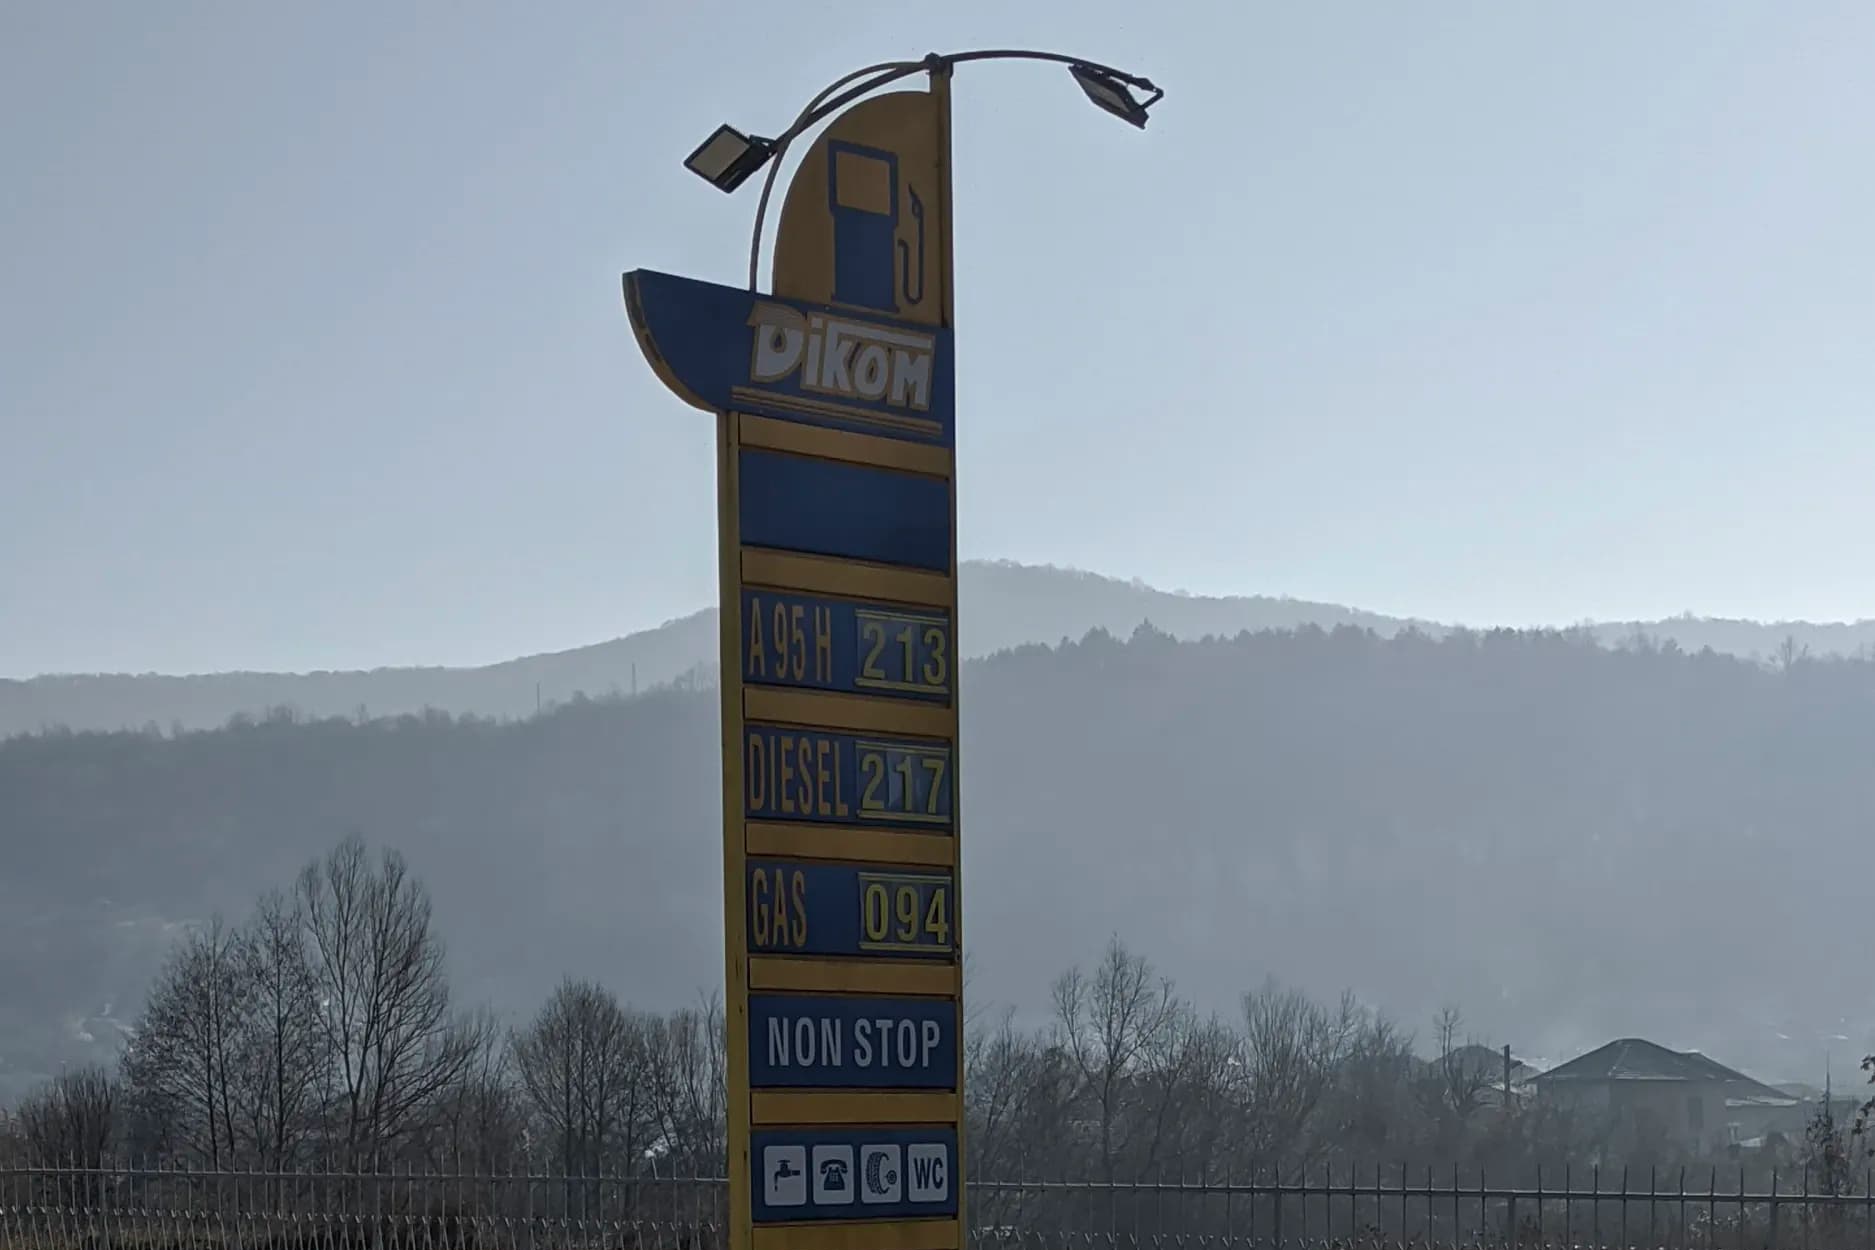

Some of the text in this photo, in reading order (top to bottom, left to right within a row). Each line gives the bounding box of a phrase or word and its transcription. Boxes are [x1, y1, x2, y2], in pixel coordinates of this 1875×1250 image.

[863, 622, 946, 685] 213
[750, 734, 849, 817] DIESEL
[861, 753, 946, 814] 217
[753, 868, 808, 947] GAS
[864, 884, 948, 943] 094
[768, 1017, 940, 1068] NON STOP
[914, 1157, 944, 1190] WC
